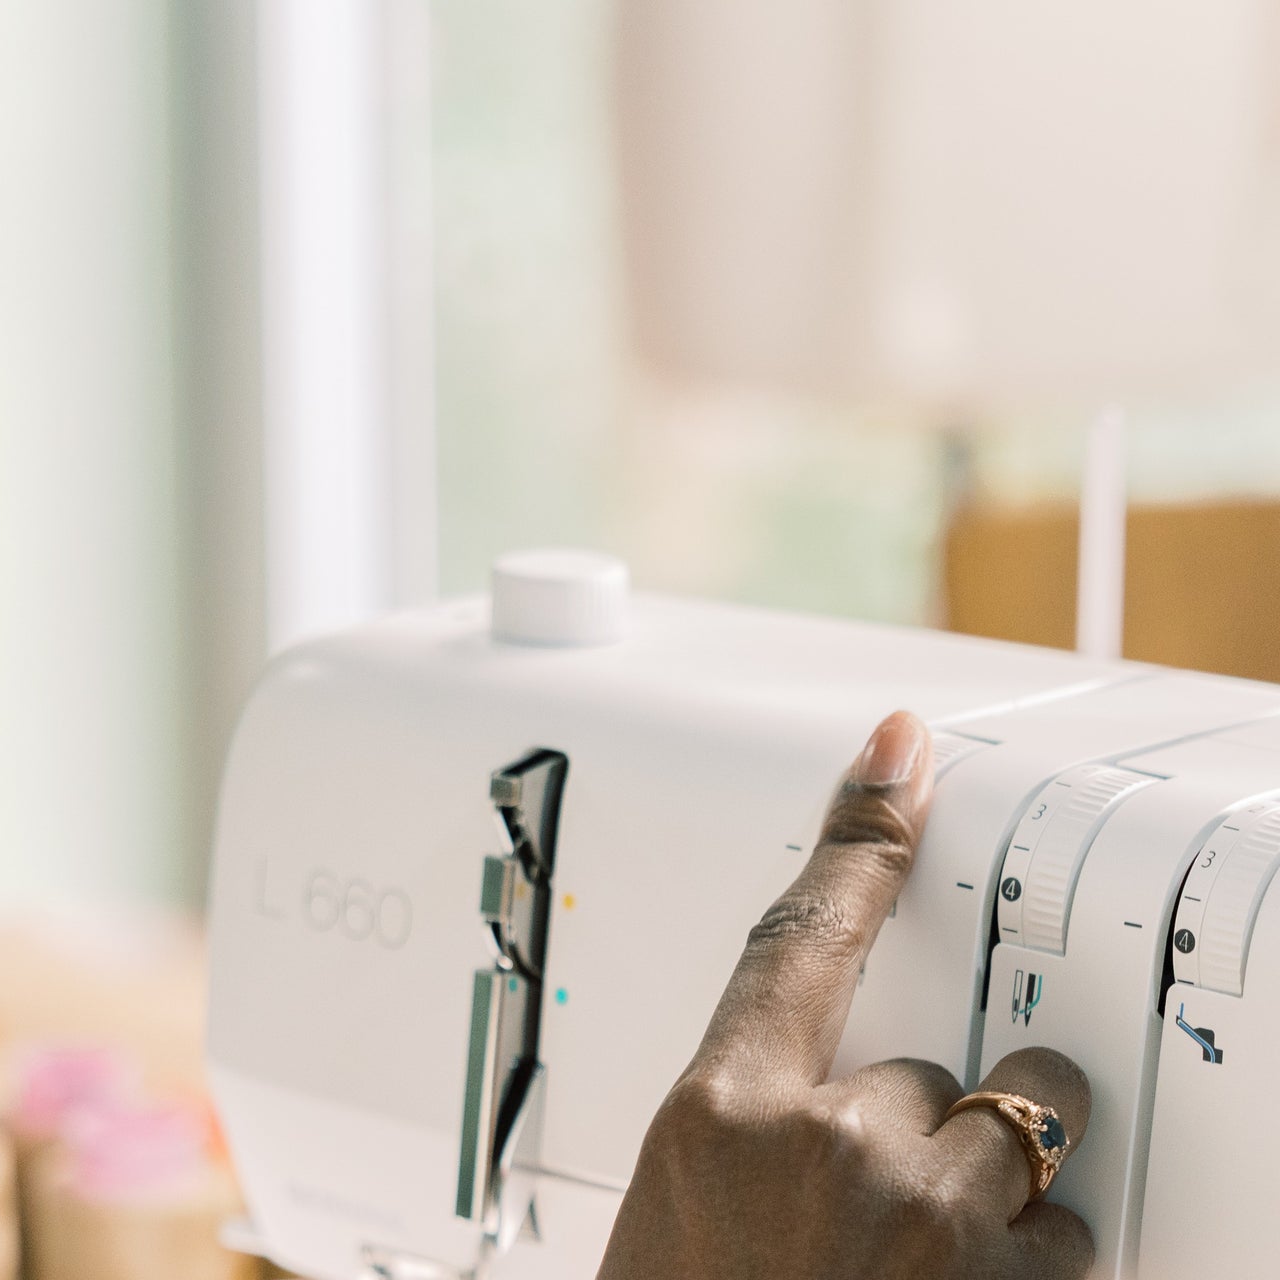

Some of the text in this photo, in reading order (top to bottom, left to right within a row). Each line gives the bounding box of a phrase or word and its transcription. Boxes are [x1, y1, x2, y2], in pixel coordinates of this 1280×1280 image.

[1031, 803, 1047, 820] 3
[1200, 850, 1216, 869] 3
[254, 854, 413, 951] L 660
